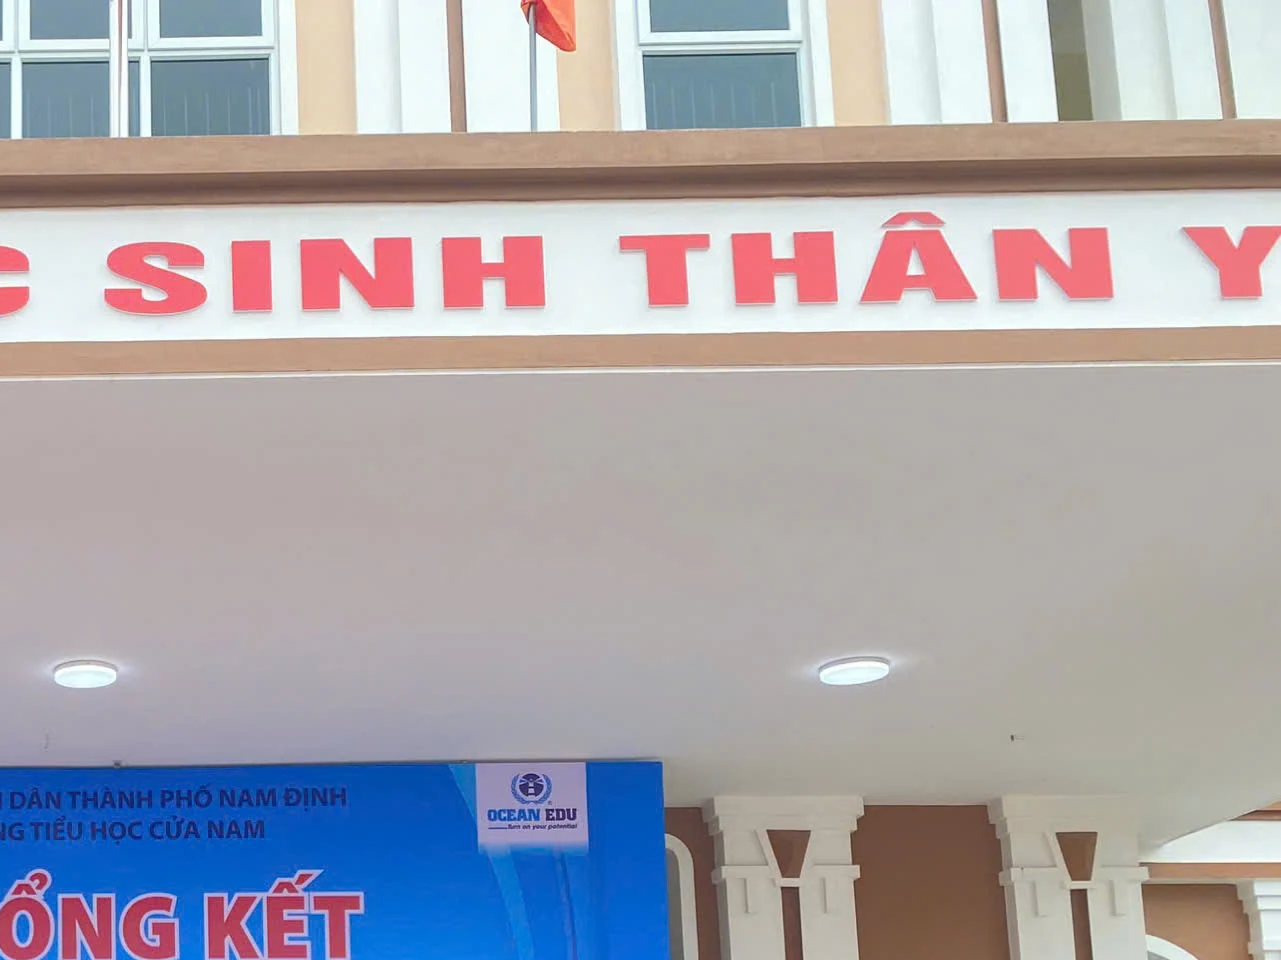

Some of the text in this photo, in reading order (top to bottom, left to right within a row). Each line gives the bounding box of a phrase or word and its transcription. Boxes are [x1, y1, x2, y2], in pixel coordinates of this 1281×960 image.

[104, 236, 546, 315] SINH
[618, 211, 1114, 307] THÂN
[9, 787, 62, 810] DÂN
[68, 787, 153, 809] THÀNH
[160, 784, 213, 809] PHỐ
[220, 787, 277, 808] NAM
[283, 786, 347, 812] ĐỊNH
[487, 808, 577, 822] OCEAN EDU
[30, 815, 83, 841] TIỂU
[91, 820, 143, 845] HỌC
[149, 815, 201, 840] CỬA
[208, 819, 266, 840] NAM
